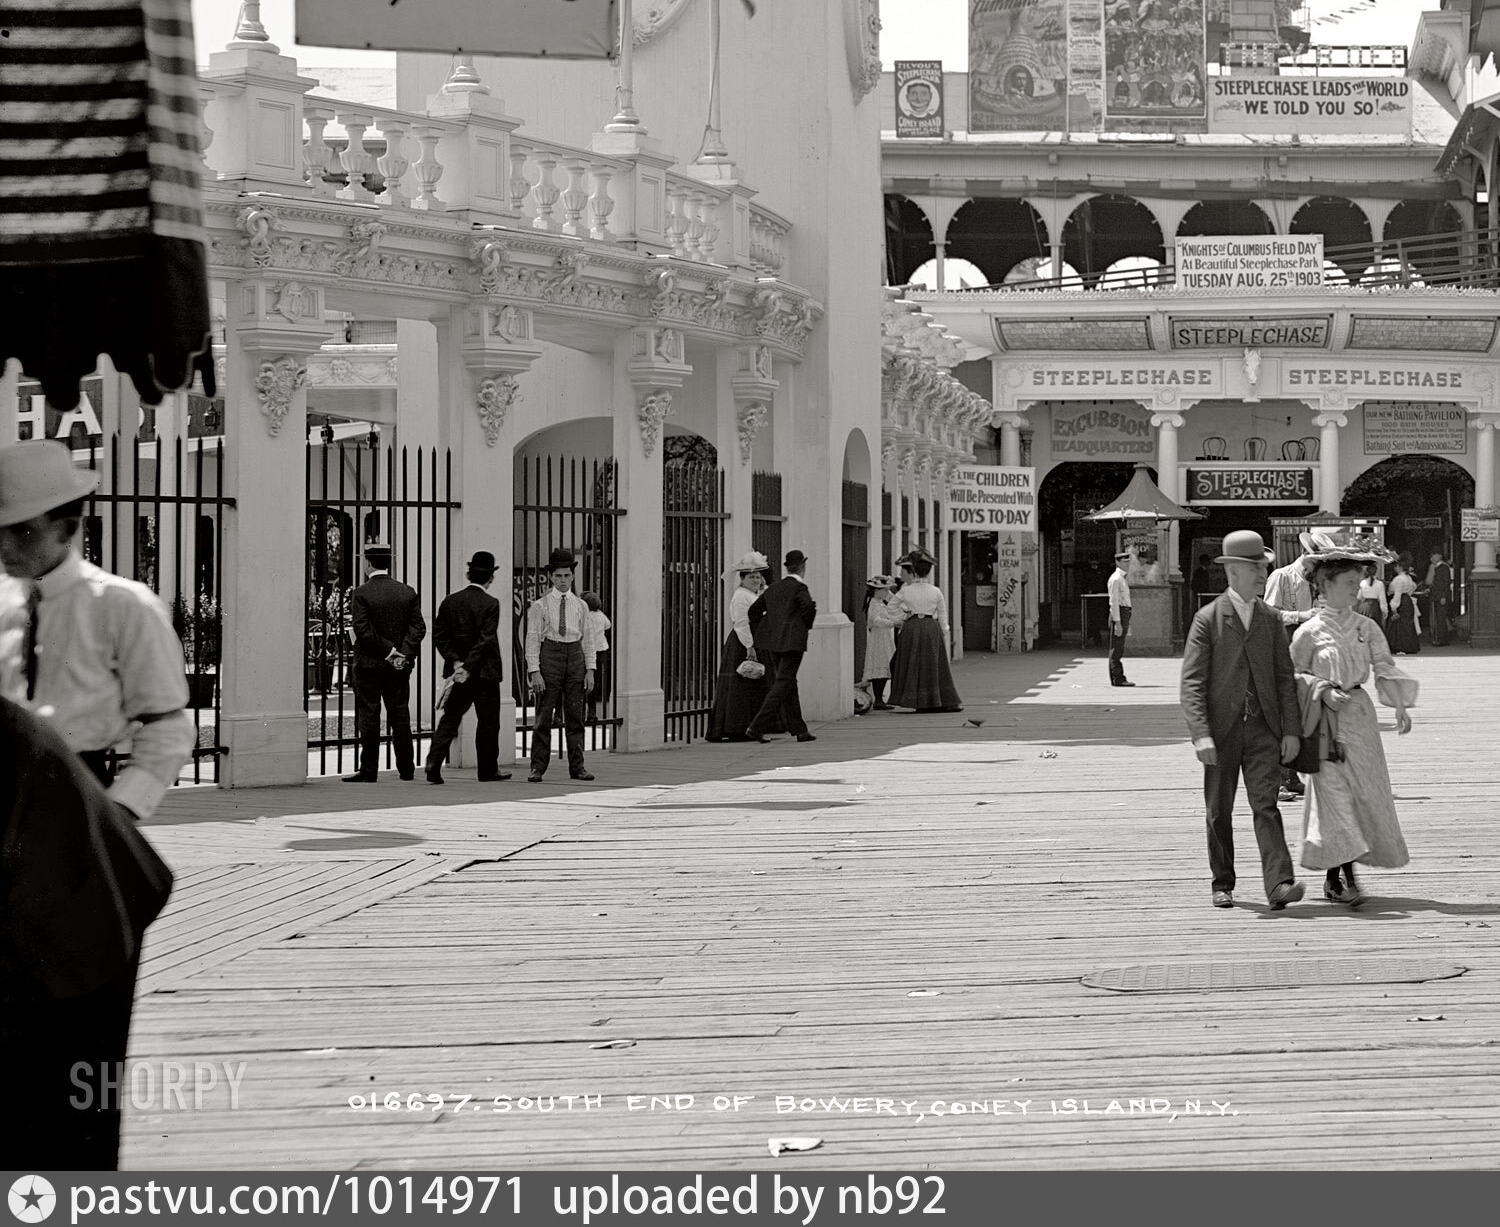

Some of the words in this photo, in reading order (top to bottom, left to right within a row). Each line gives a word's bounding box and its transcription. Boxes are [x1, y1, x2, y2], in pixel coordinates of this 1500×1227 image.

[1215, 80, 1309, 96] STEEPLECHASE
[1313, 80, 1351, 96] LEADS
[1366, 80, 1409, 97] WORLD
[1244, 100, 1269, 114] WE
[1274, 100, 1309, 115] TOLD
[1315, 100, 1345, 115] YOU
[1353, 98, 1380, 116] SO!
[1227, 242, 1271, 256] COLUMBUS
[1273, 241, 1296, 256] FIELD
[1182, 259, 1193, 270] At
[1195, 258, 1238, 270] Beautiful
[1240, 258, 1299, 271] Steeplechase
[1300, 257, 1319, 268] Park
[1182, 273, 1234, 288] TUESDAY
[1236, 273, 1268, 287] AUG.
[1178, 326, 1324, 345] STEEPLECHASE
[1033, 369, 1212, 386] STEEPLECHASE
[1289, 369, 1463, 388] STEEPLECHASE
[1380, 411, 1393, 419] NEW
[1394, 409, 1424, 421] BATHING
[1425, 409, 1462, 420] PAVILION
[1053, 410, 1150, 437] EXCURSION
[1052, 439, 1153, 456] HEADQUARTERS
[1366, 440, 1391, 452] Bathing
[963, 471, 975, 481] THE
[976, 472, 1030, 487] CHILDREN
[1196, 470, 1308, 497] STEEPLECHASE
[950, 489, 966, 503] Will
[966, 489, 977, 503] Be
[977, 490, 1016, 505] Presented
[1017, 491, 1034, 506] With
[1230, 486, 1282, 500] PARK
[950, 508, 985, 524] TOYS
[1001, 549, 1017, 557] ICE
[1000, 559, 1019, 568] CREAM
[999, 577, 1019, 607] SODA
